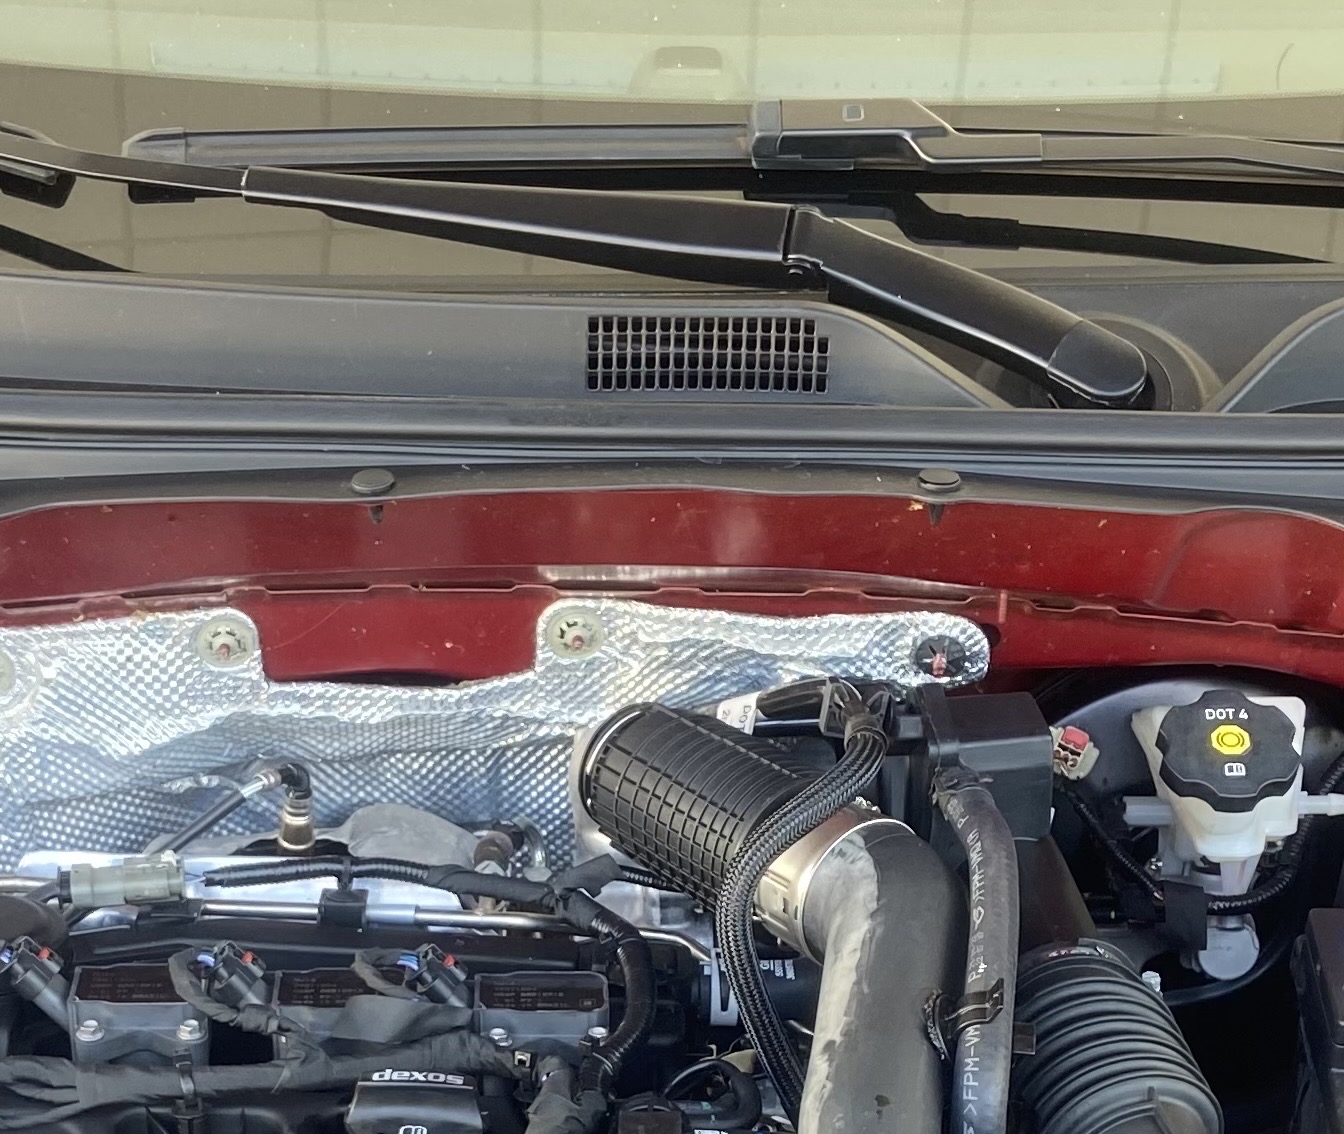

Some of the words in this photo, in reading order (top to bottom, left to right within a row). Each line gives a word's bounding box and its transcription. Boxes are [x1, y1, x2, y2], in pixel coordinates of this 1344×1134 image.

[1205, 708, 1235, 720] DOT
[1239, 709, 1248, 719] 4
[372, 1068, 464, 1085] dexos
